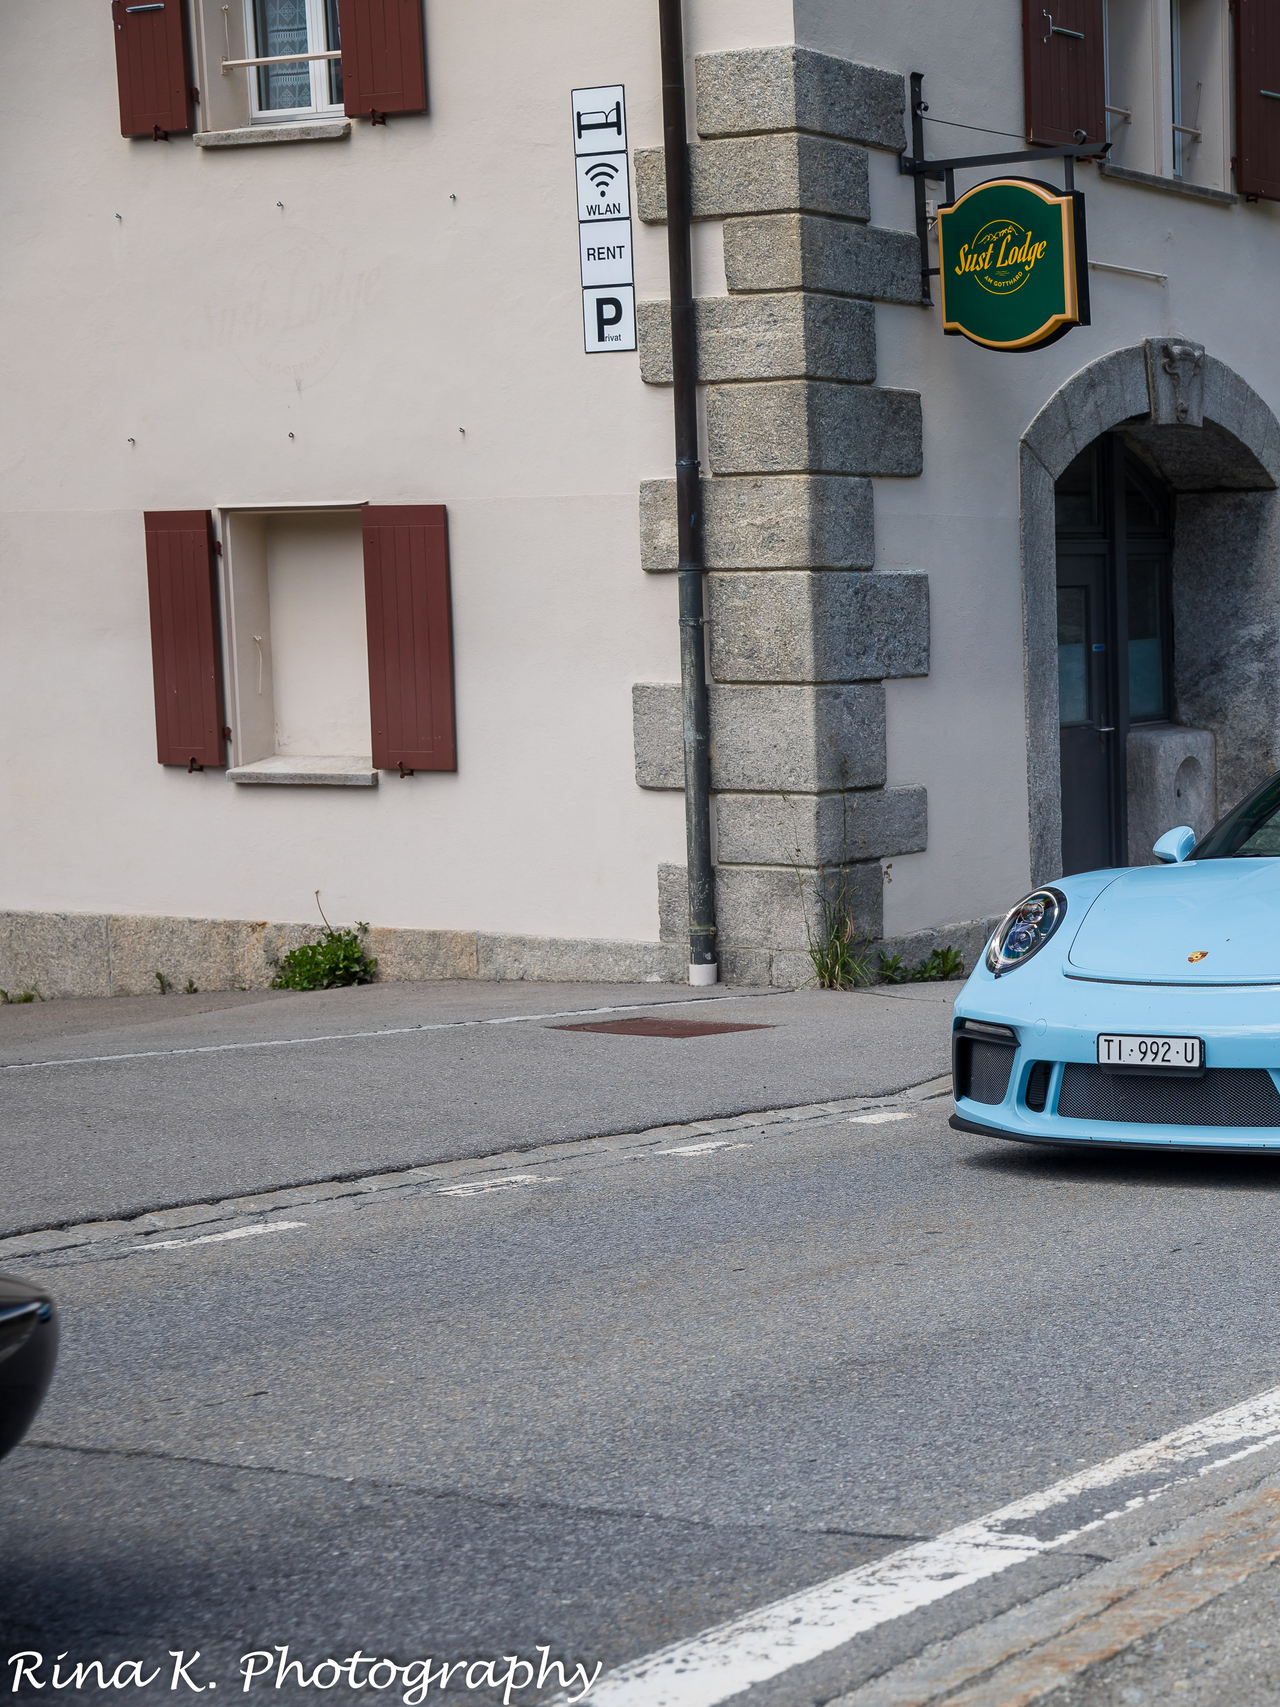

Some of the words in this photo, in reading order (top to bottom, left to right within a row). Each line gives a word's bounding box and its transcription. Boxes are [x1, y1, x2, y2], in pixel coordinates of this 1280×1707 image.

[586, 202, 621, 216] WLAN
[586, 245, 626, 262] RENT
[954, 243, 994, 276] Sust
[996, 230, 1048, 271] Lodge
[984, 275, 994, 285] AM
[993, 271, 1023, 287] GOTTHARD
